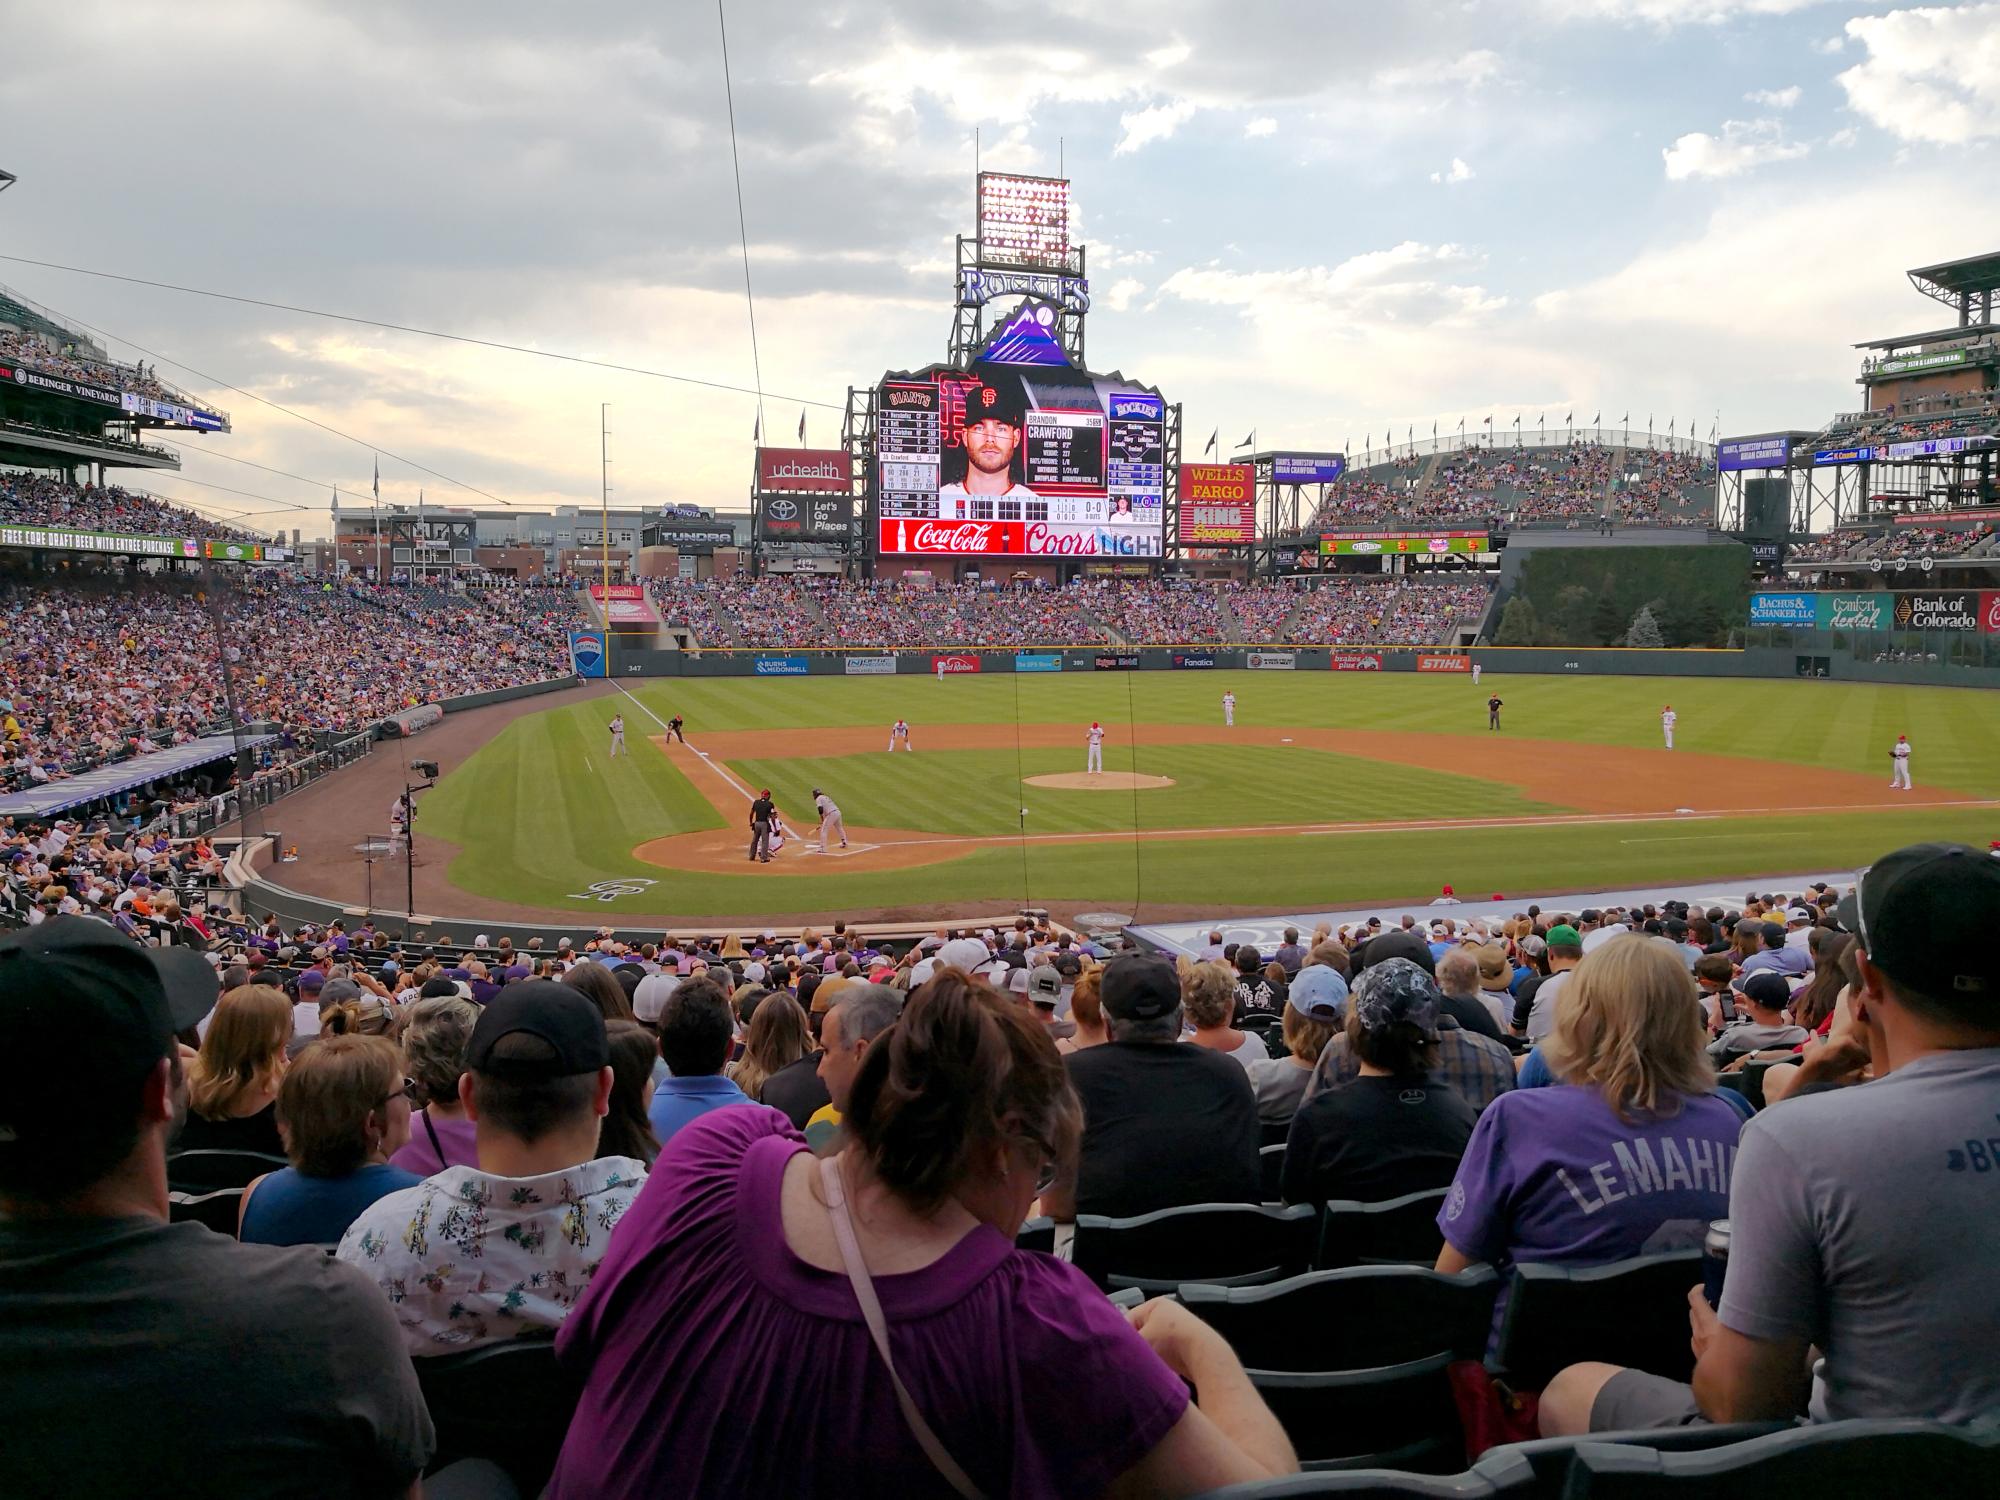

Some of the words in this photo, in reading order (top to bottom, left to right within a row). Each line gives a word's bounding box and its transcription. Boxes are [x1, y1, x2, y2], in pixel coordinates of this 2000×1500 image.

[959, 269, 1089, 311] ROCKIES
[28, 375, 72, 392] BERINGER
[76, 386, 119, 404] VINEYARDS
[889, 391, 931, 407] GIANTS
[1029, 416, 1057, 424] BRANDON
[1028, 427, 1072, 439] CRAWFORD
[1738, 443, 1761, 453] SHORTSTOP
[1762, 441, 1779, 450] NUMBER
[1780, 439, 1785, 448] 35
[1756, 449, 1783, 459] CRAWFORD.
[773, 459, 839, 478] uchealth
[1191, 468, 1244, 482] WELLS
[1192, 486, 1244, 498] FARGO
[815, 501, 837, 511] Let's
[673, 508, 701, 518] TOYOTA
[814, 512, 828, 521] Go
[1193, 508, 1241, 524] KING
[768, 521, 800, 530] TOYOTA
[815, 521, 847, 531] Places
[2, 529, 23, 544] FREE
[48, 532, 73, 548] DRAFT
[75, 535, 94, 549] BEER
[96, 536, 114, 550] WITH
[143, 540, 175, 556] PURCHASE
[662, 532, 731, 542] TUNDRA
[914, 523, 992, 551] Coca-Cola
[1026, 523, 1097, 555] Coors
[1102, 536, 1161, 556] LIGHT
[599, 587, 634, 597] uhealth
[1759, 597, 1794, 608] BACHUS
[1833, 595, 1875, 612] Comfort
[1913, 596, 1946, 612] Bank
[1949, 596, 1964, 612] of
[1751, 607, 1795, 618] SCHANKER
[1798, 610, 1814, 618] LLC
[1830, 608, 1880, 628] dental
[1913, 612, 1975, 627] Colorado
[953, 662, 973, 671] Robin
[1339, 662, 1354, 670] plus
[1422, 659, 1465, 668] STIHL
